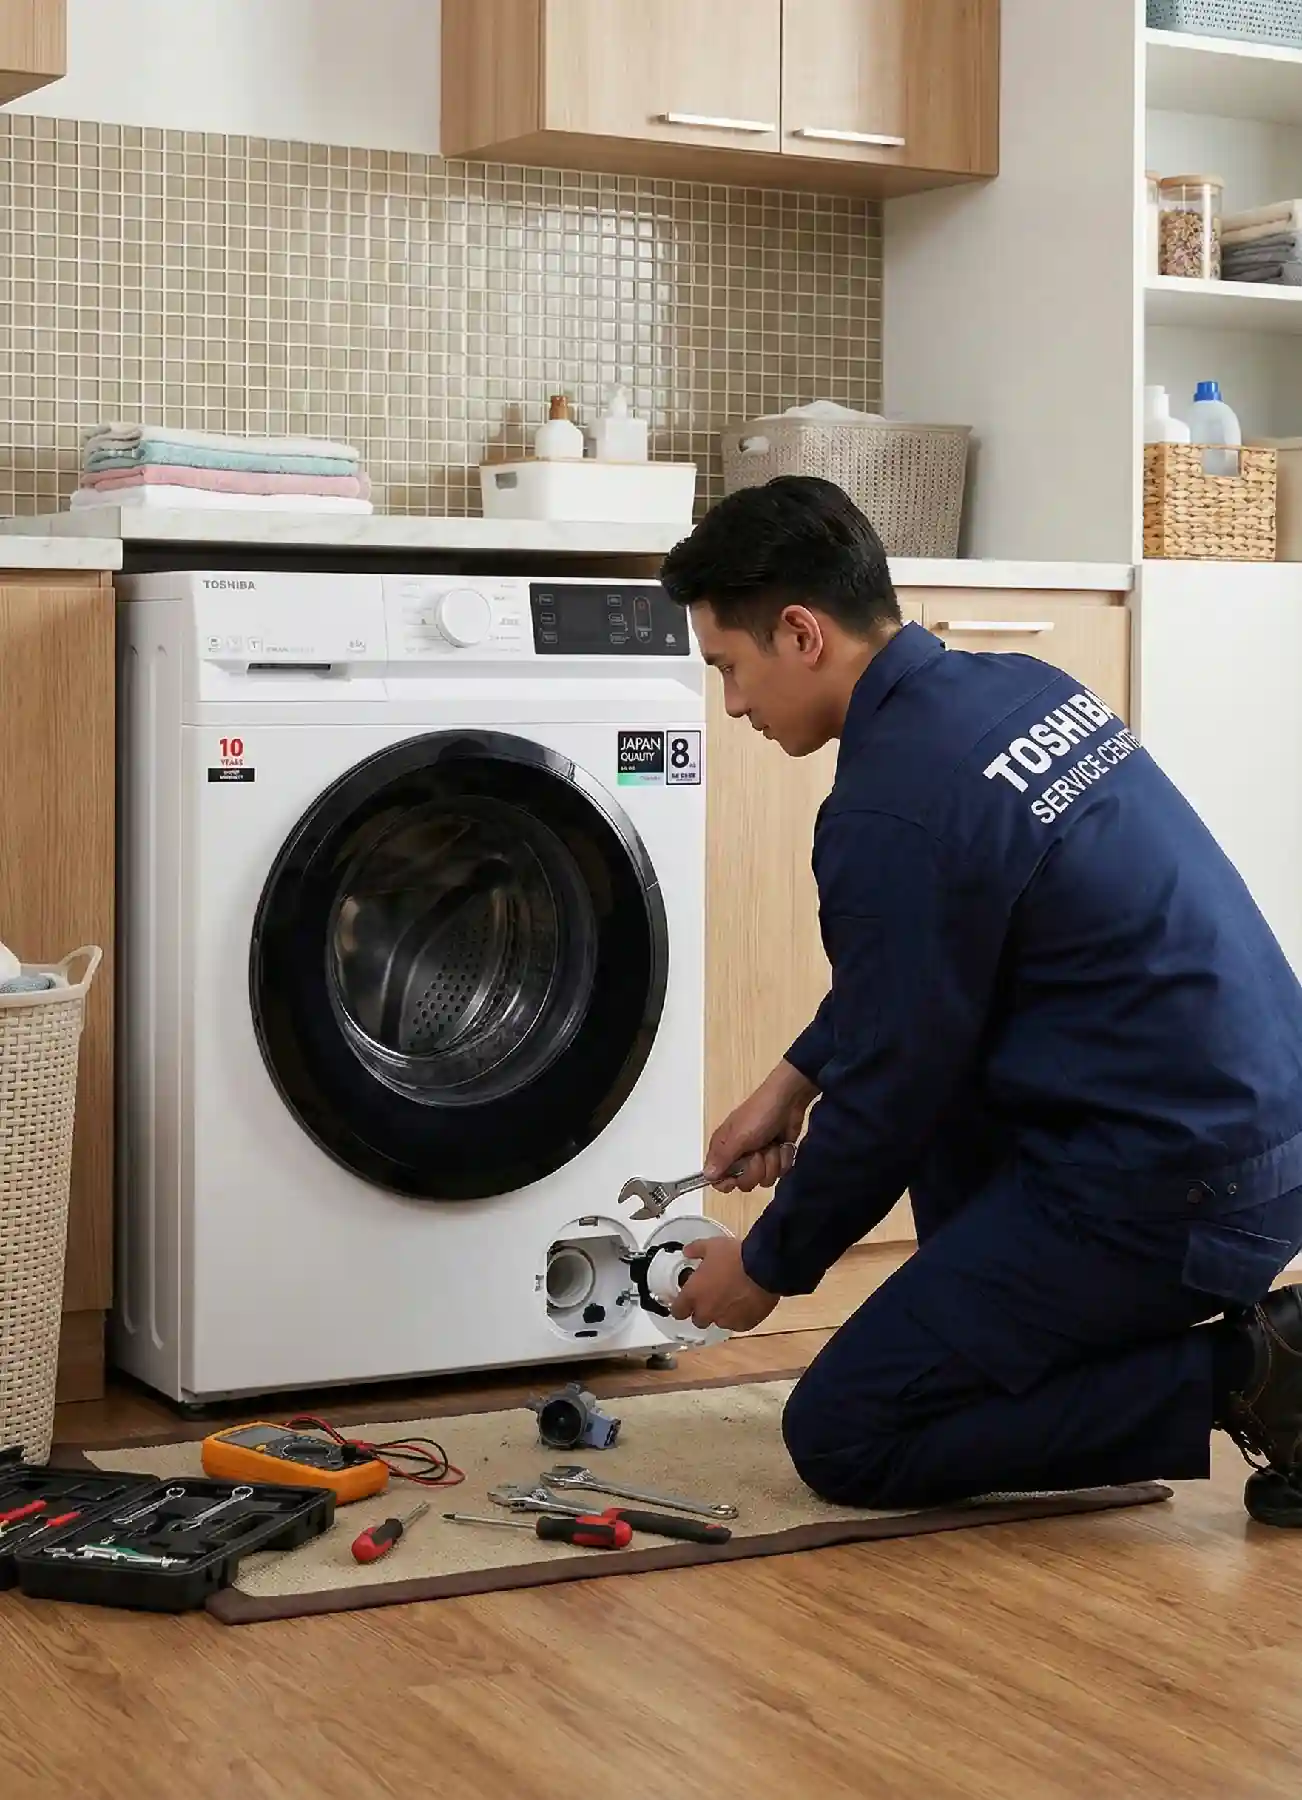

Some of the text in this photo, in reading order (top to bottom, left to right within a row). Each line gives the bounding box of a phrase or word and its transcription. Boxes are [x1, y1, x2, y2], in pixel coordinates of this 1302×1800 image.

[203, 580, 256, 590] TOSHIBA
[219, 738, 244, 757] 10
[620, 737, 661, 751] JAPAN
[620, 752, 656, 762] QUALITY
[671, 738, 690, 769] 8
[1030, 754, 1110, 824] SERVICE
